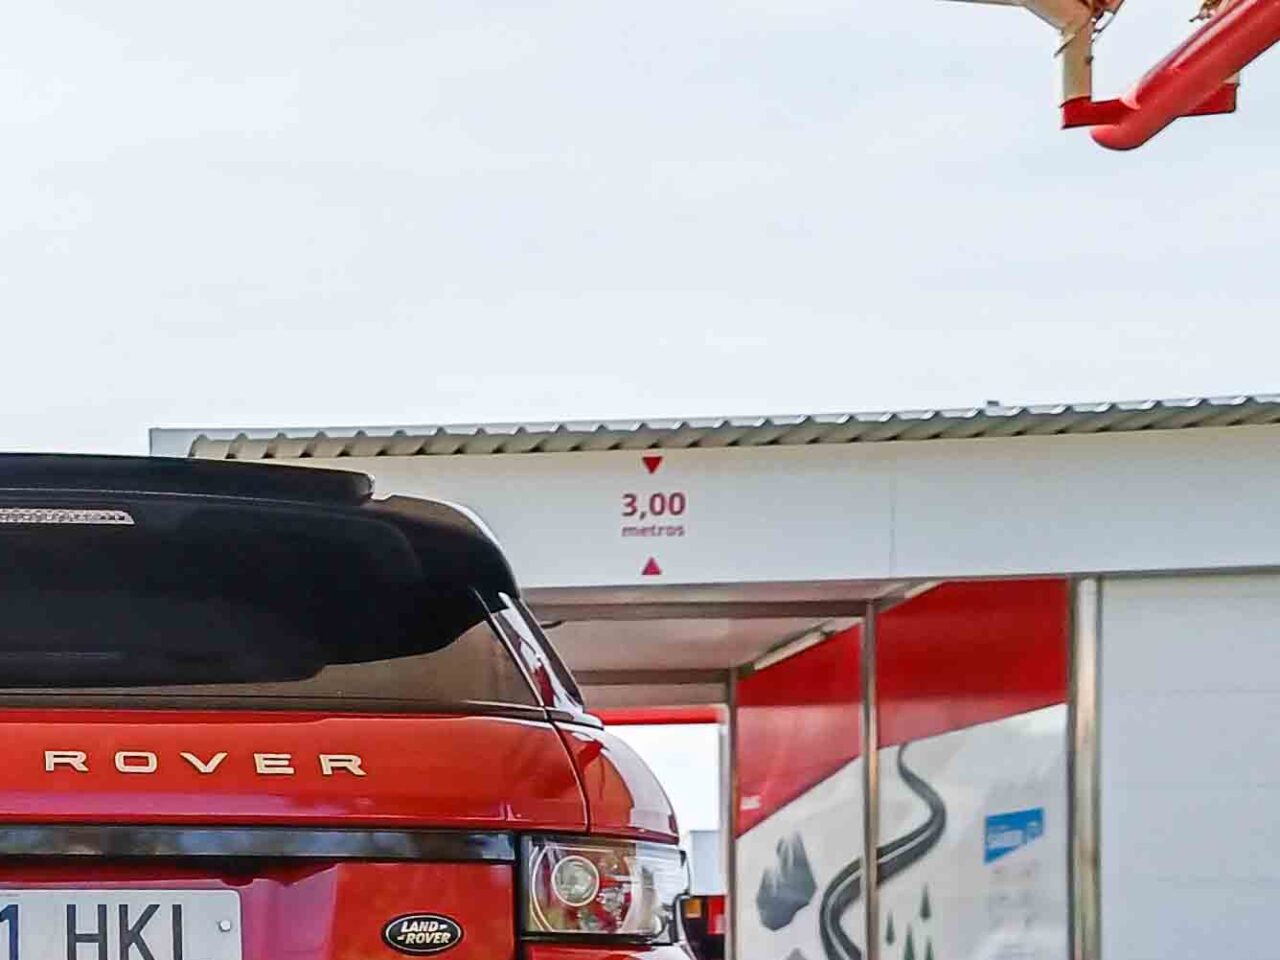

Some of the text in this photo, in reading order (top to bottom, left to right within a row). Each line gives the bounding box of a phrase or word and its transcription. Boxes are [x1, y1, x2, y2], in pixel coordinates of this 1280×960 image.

[622, 491, 686, 520] 3,00
[622, 525, 684, 537] metros
[43, 750, 367, 776] ROVER
[400, 921, 439, 933] LAND
[405, 932, 452, 945] ROVER
